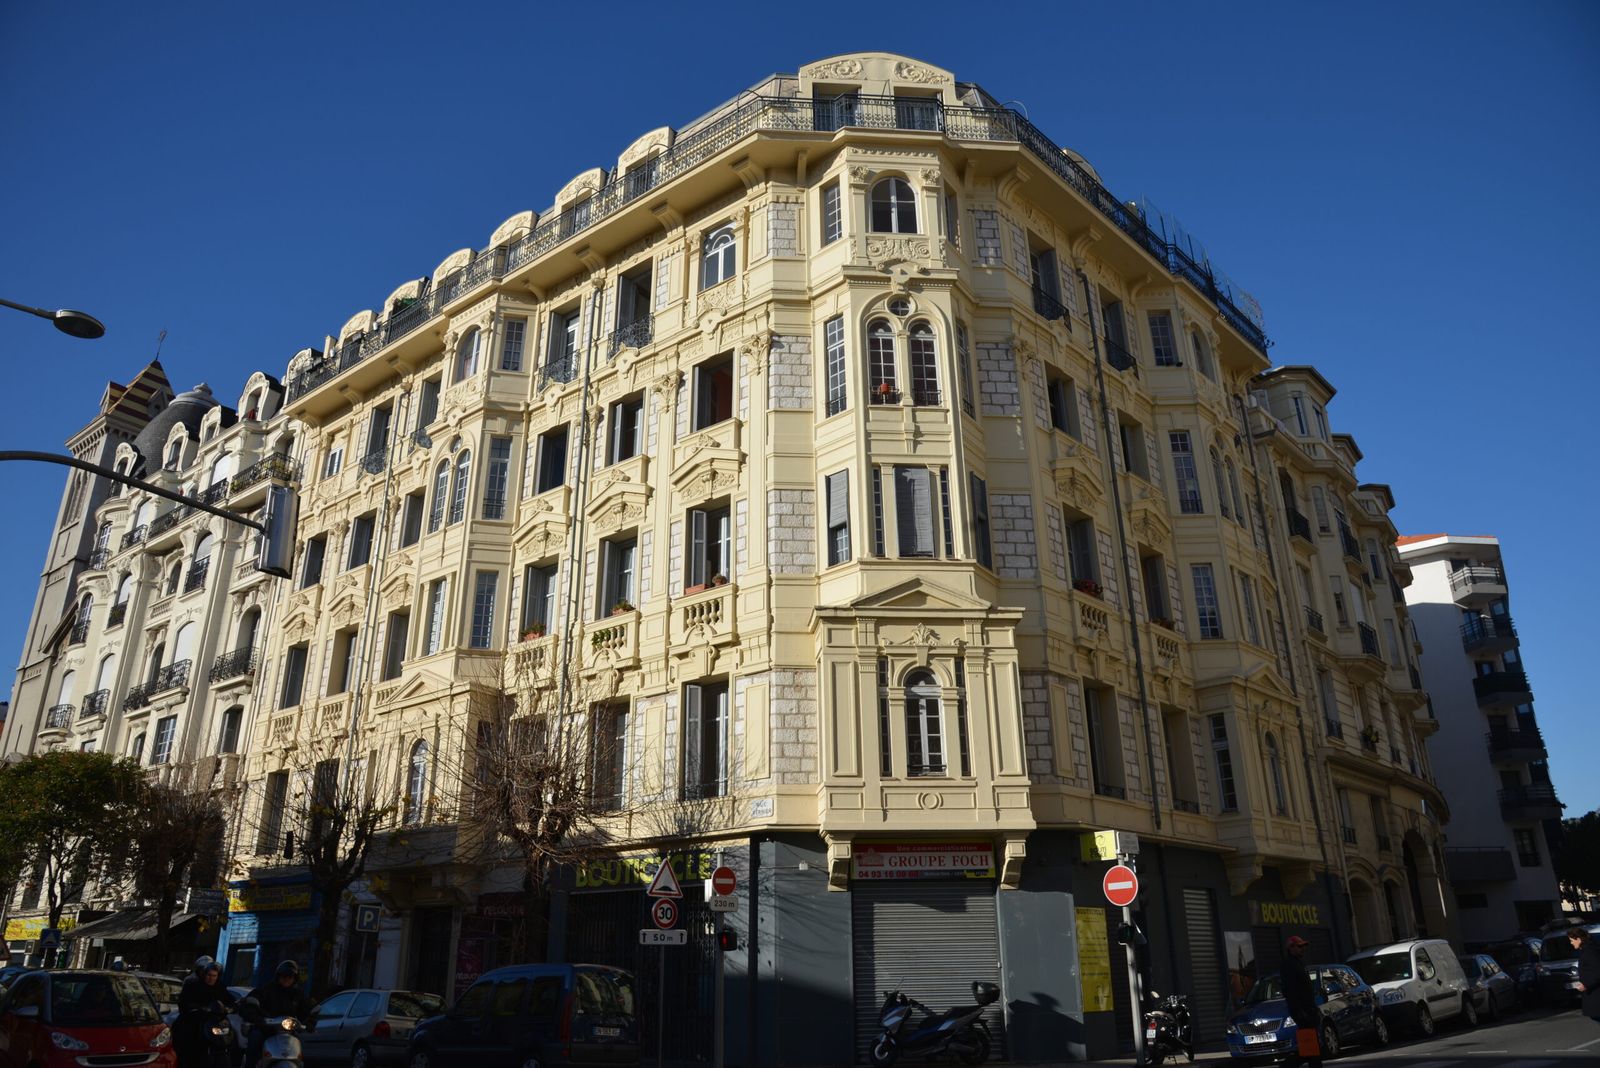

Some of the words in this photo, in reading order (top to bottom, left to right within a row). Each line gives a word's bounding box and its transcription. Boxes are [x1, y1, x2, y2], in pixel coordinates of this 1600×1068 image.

[888, 855, 946, 867] GROUPE
[952, 854, 990, 867] FOCH
[575, 852, 712, 888] BOUTICCLE
[363, 910, 374, 927] P
[658, 906, 673, 920] 30
[1260, 902, 1319, 925] BOUTICYCLE
[653, 933, 666, 942] 50
